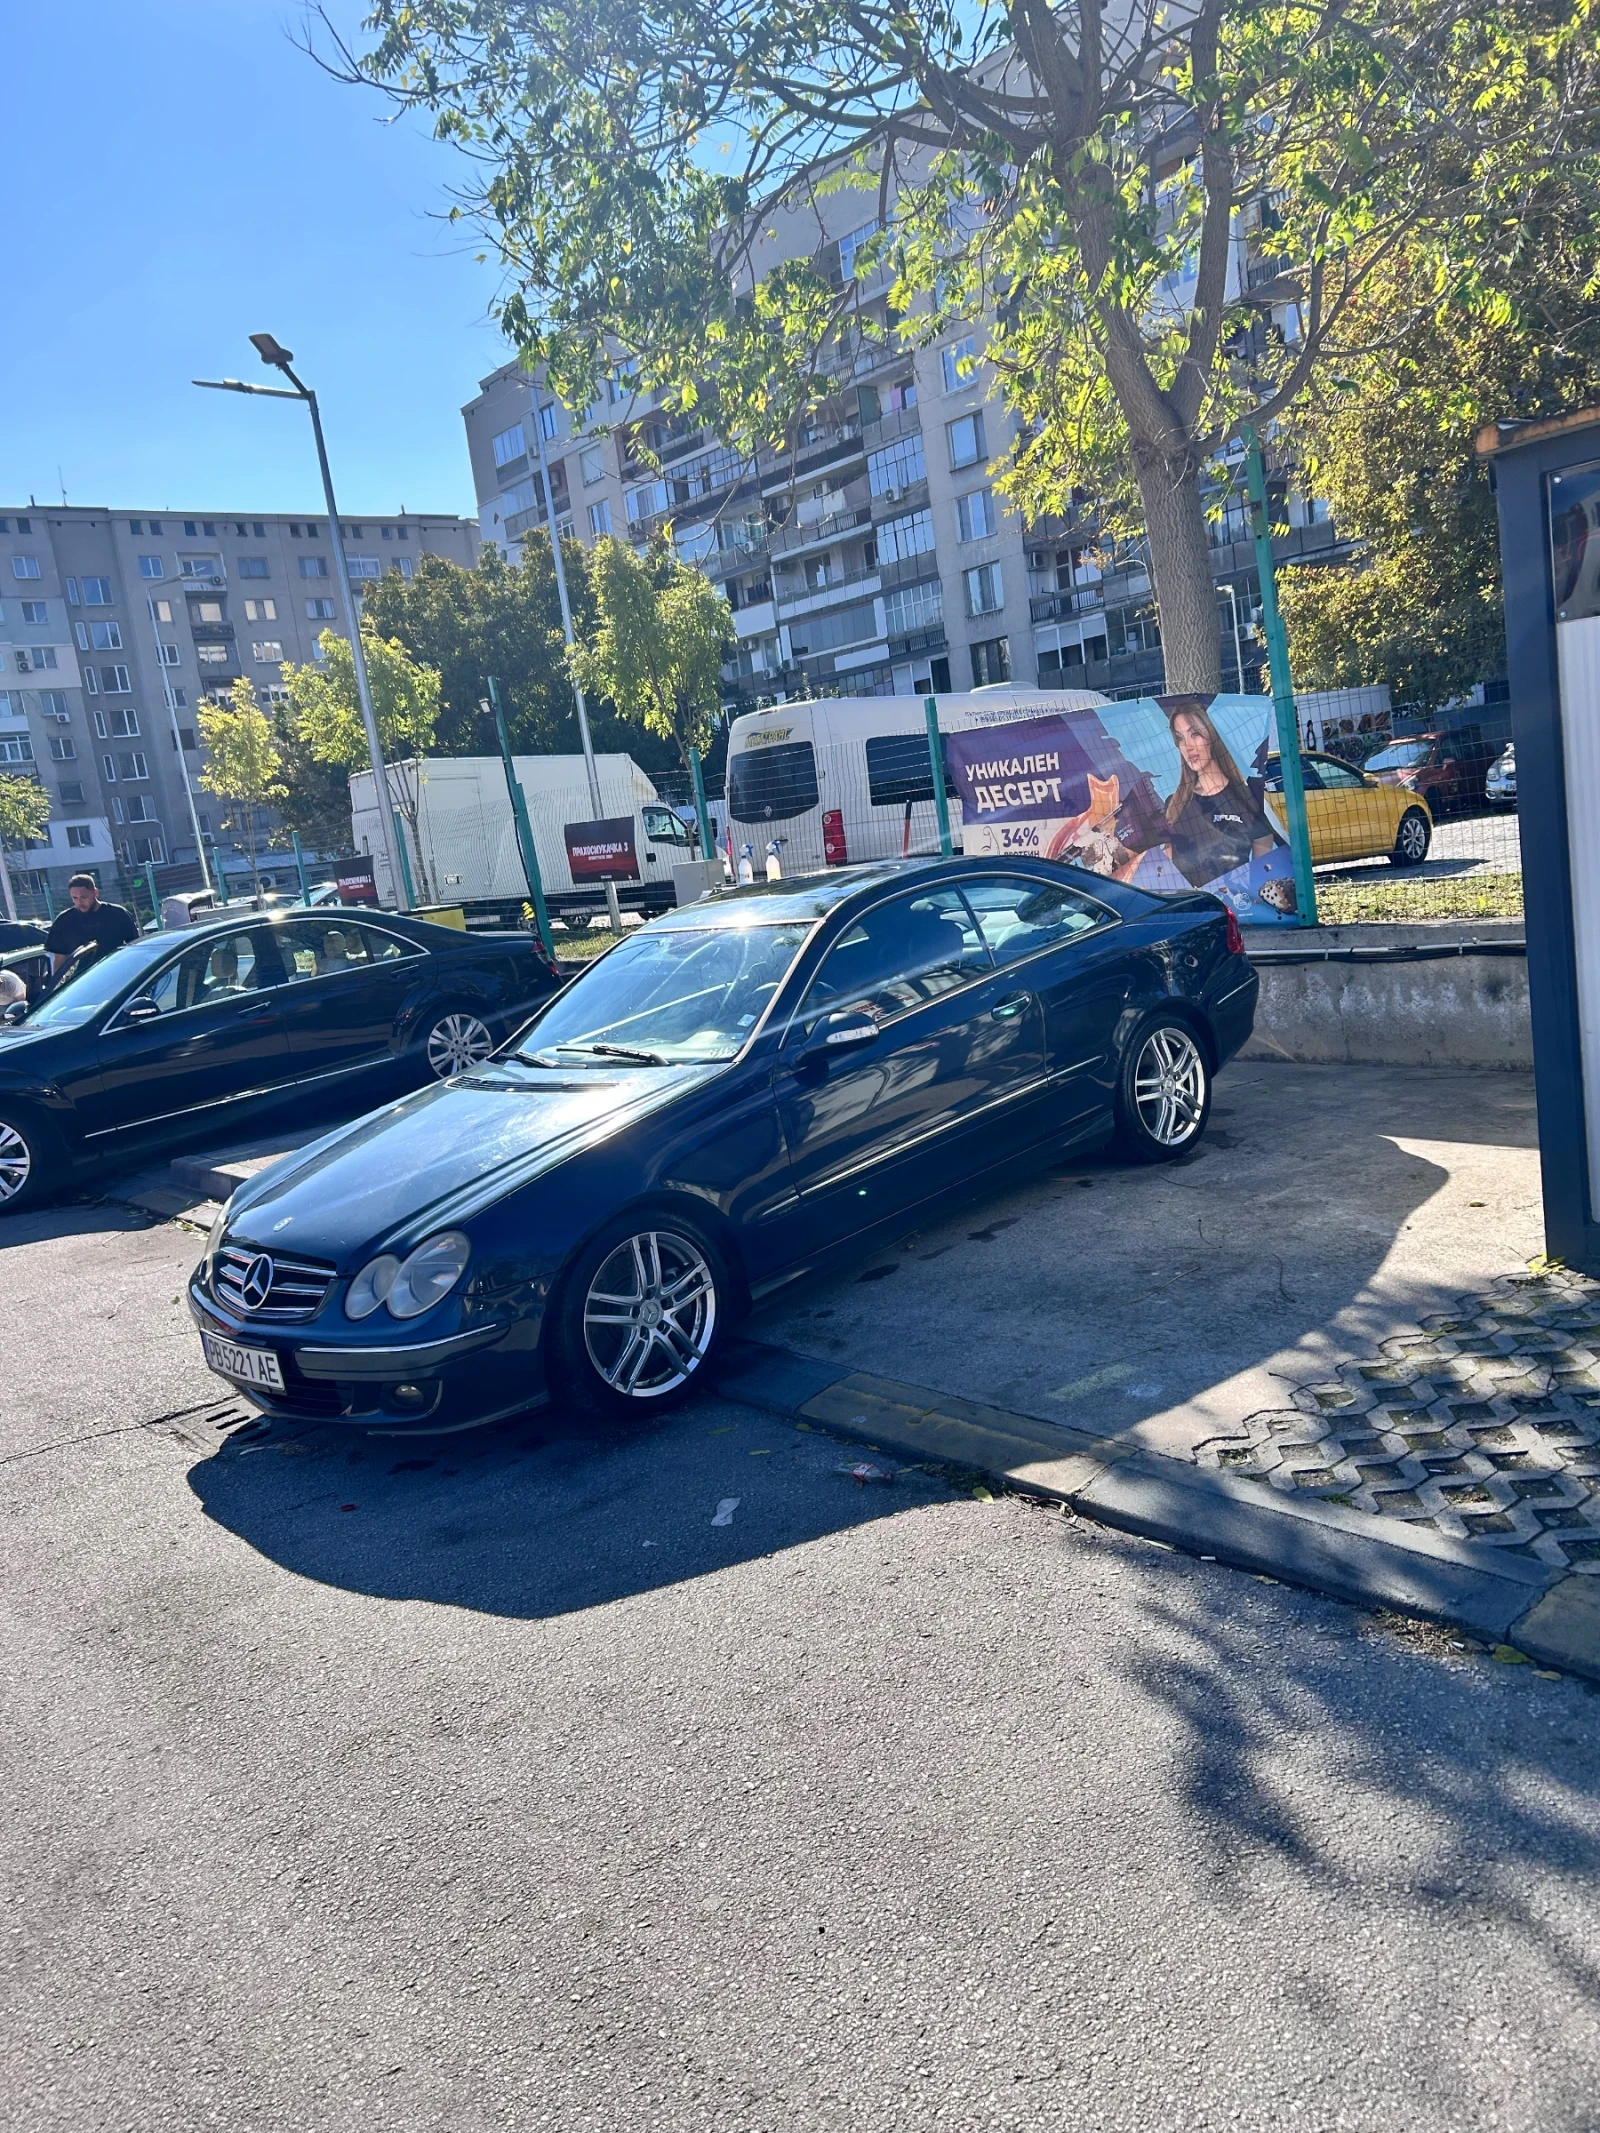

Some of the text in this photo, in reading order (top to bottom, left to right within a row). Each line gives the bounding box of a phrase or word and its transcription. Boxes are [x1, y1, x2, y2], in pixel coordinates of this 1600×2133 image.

[965, 752, 1060, 781] УНИКАЛЕН
[974, 778, 1062, 813] ДЕСЕРТ
[623, 841, 629, 852] 3
[1001, 826, 1039, 847] 34%
